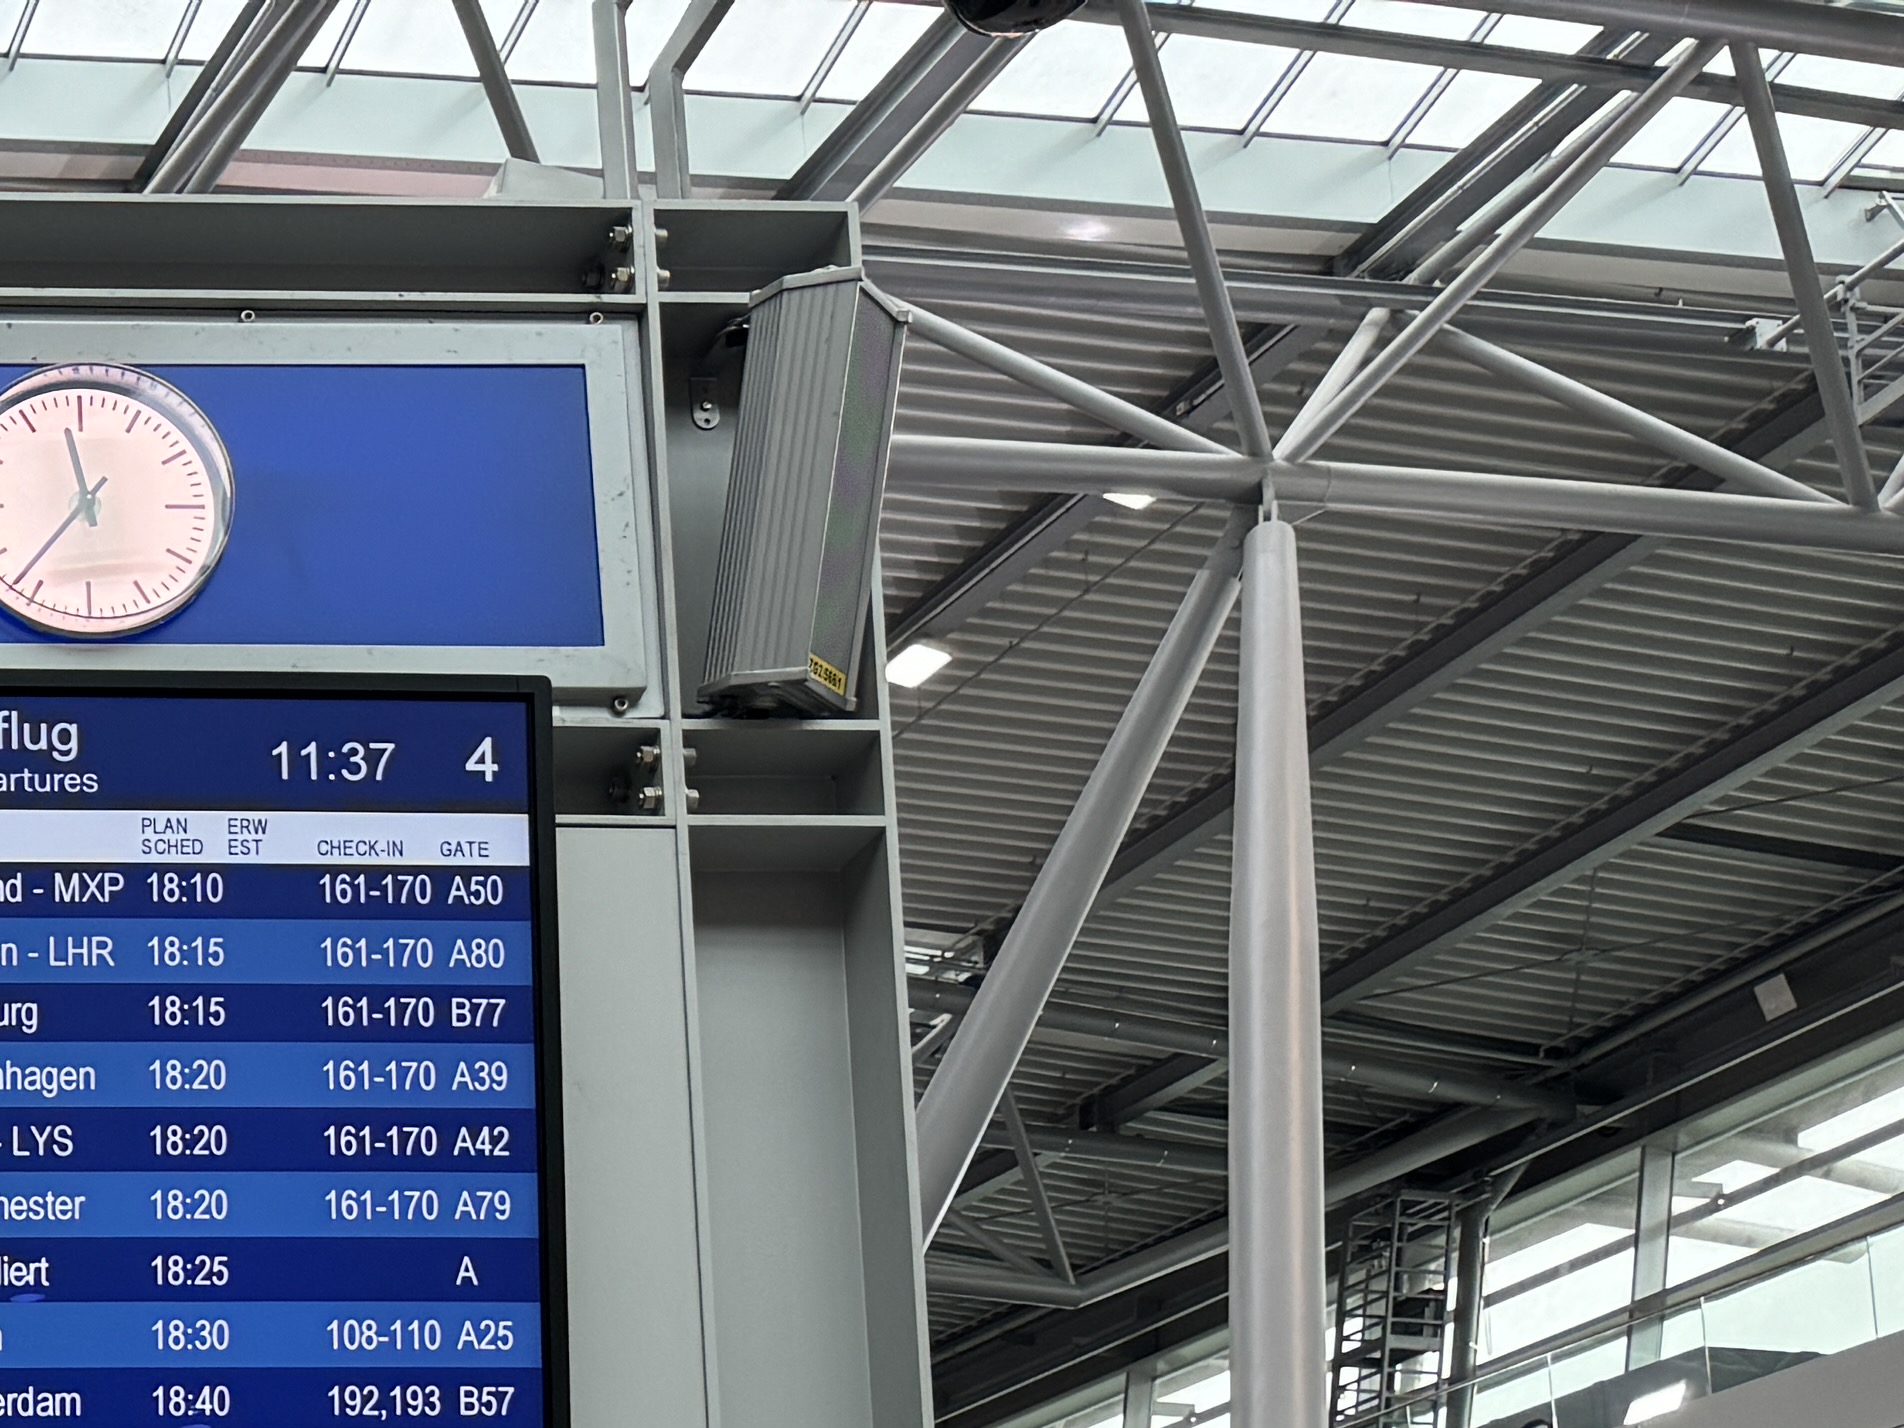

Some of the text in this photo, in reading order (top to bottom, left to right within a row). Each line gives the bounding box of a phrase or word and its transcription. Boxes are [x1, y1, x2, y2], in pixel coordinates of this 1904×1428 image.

[272, 737, 498, 781] 11:37 4
[149, 1059, 227, 1091] 18:20
[322, 1059, 436, 1091] 161-170
[451, 1060, 508, 1092] A39
